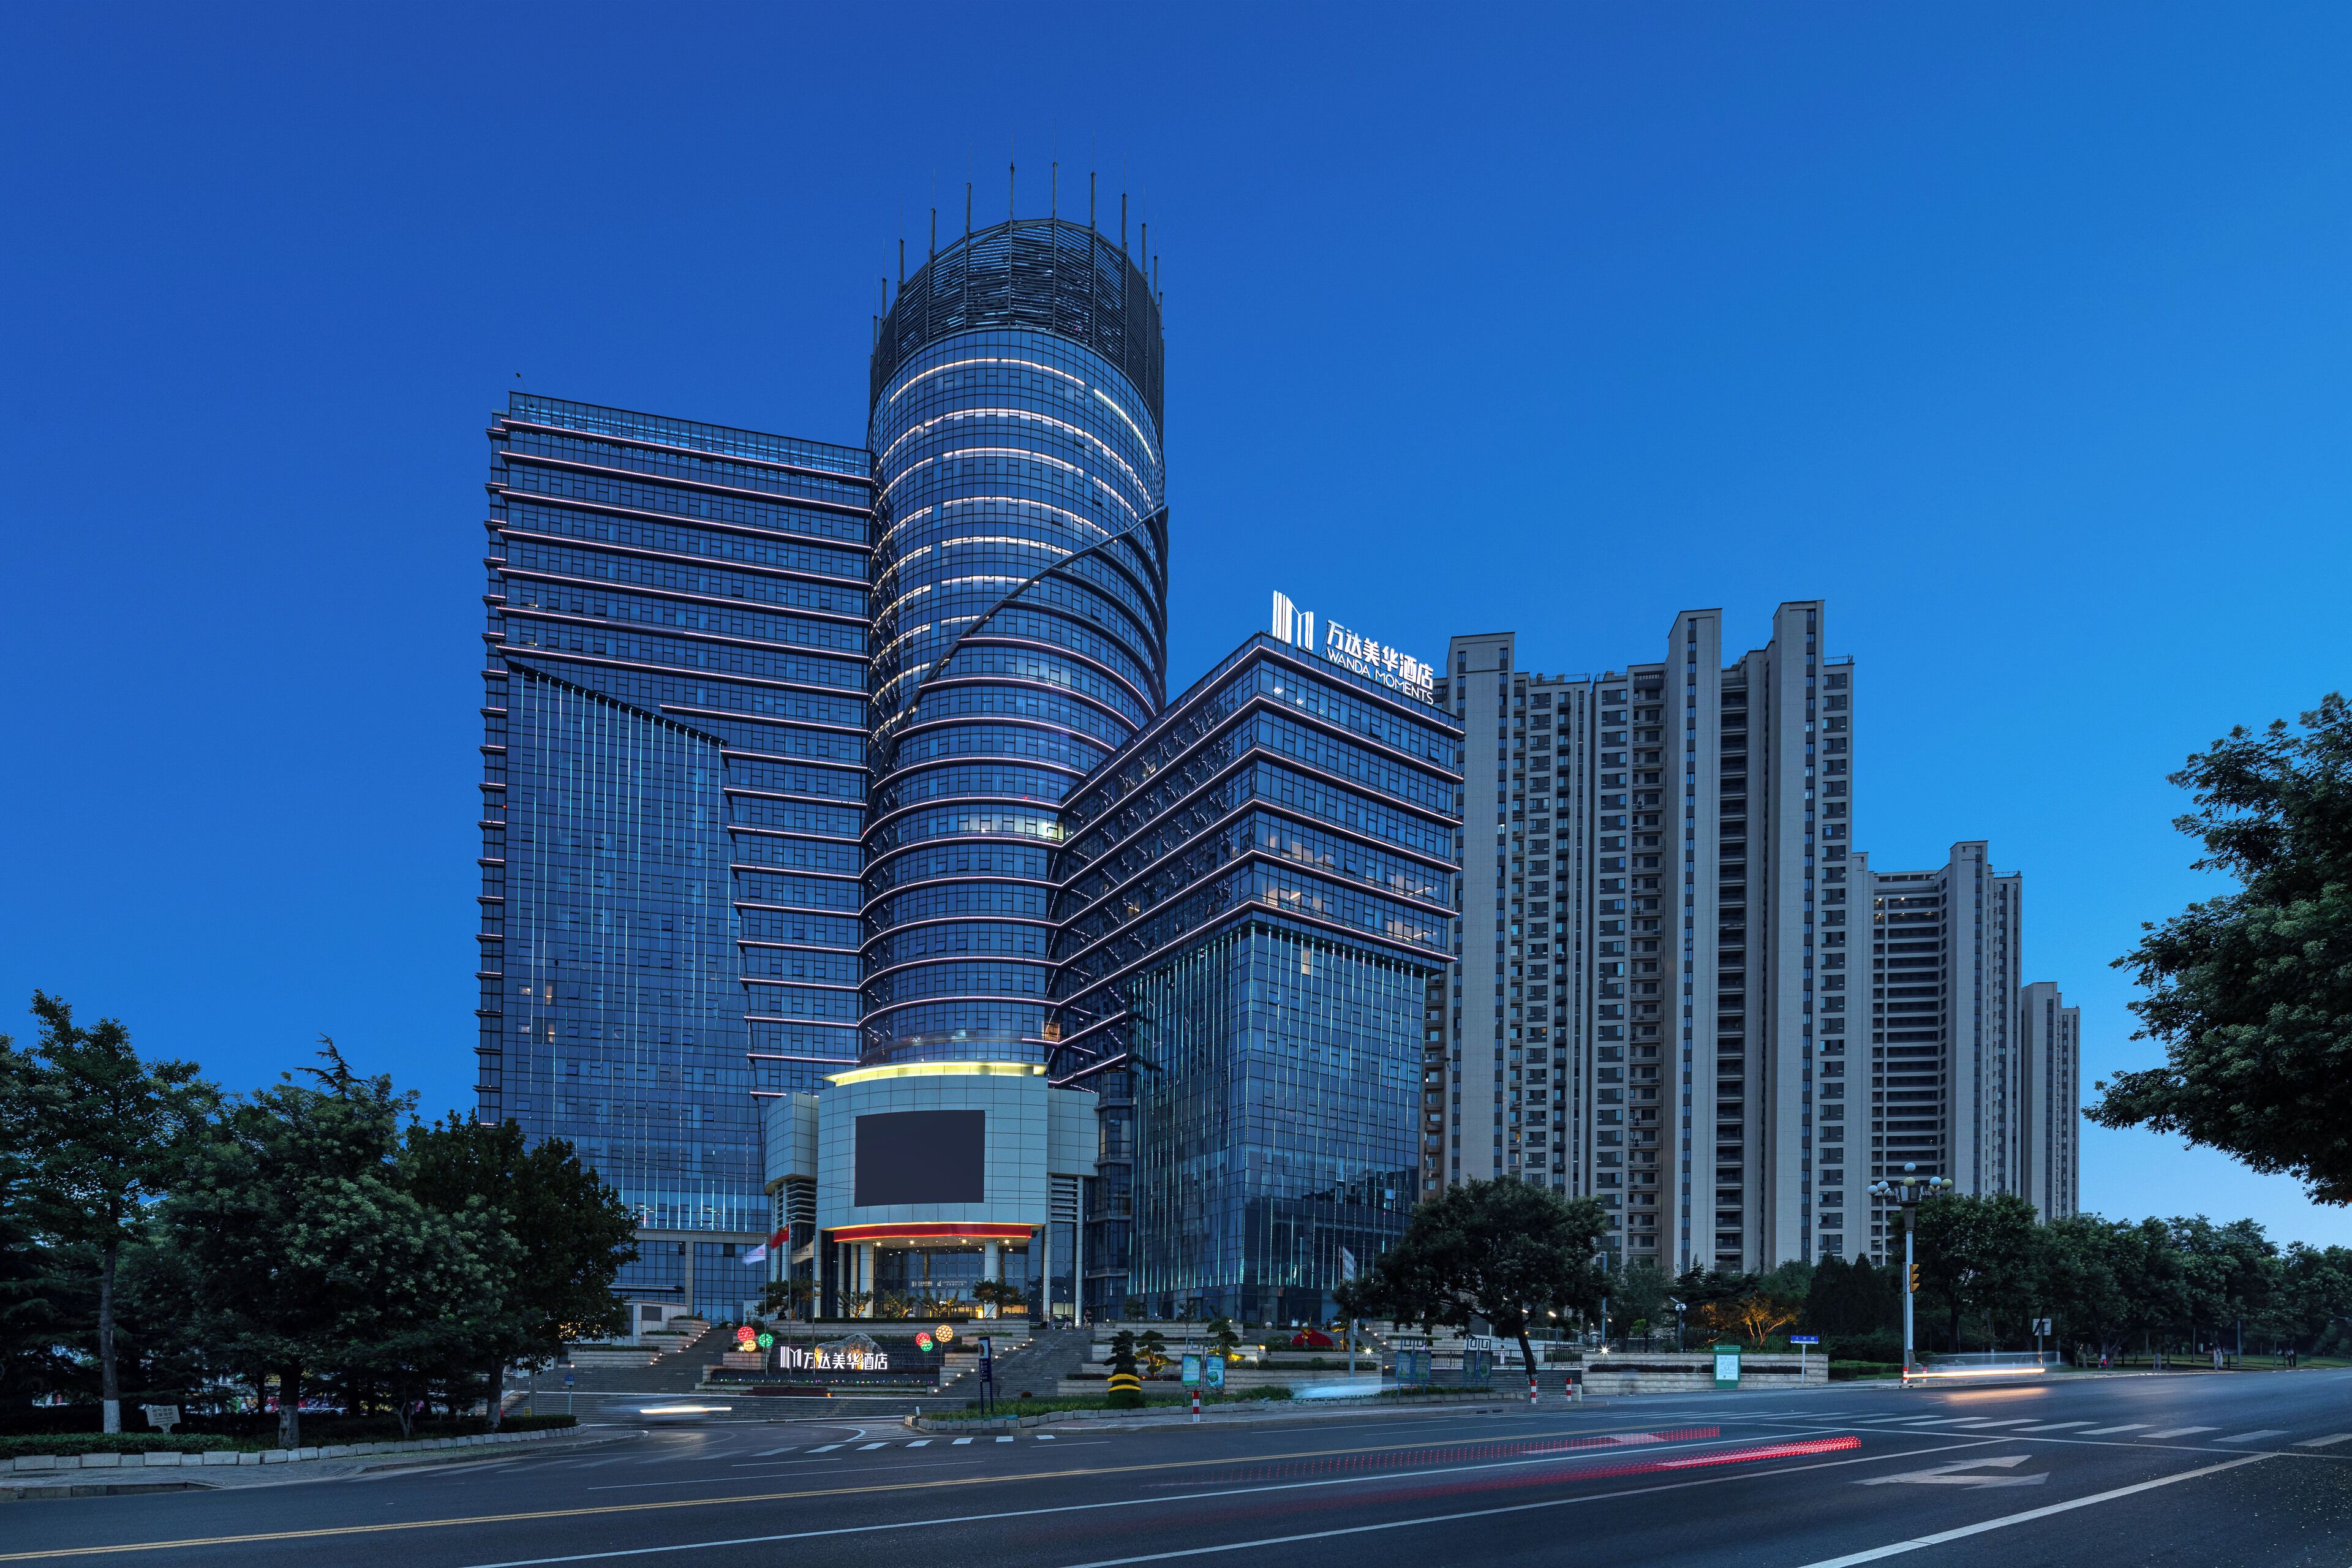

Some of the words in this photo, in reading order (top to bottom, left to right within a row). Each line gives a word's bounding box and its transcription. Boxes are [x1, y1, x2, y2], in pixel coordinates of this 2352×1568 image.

[1327, 620, 1434, 690] 万达美华酒店
[1327, 647, 1370, 678] WANDA
[1375, 669, 1434, 705] MOMENTS
[804, 1352, 888, 1370] 万达美华酒店
